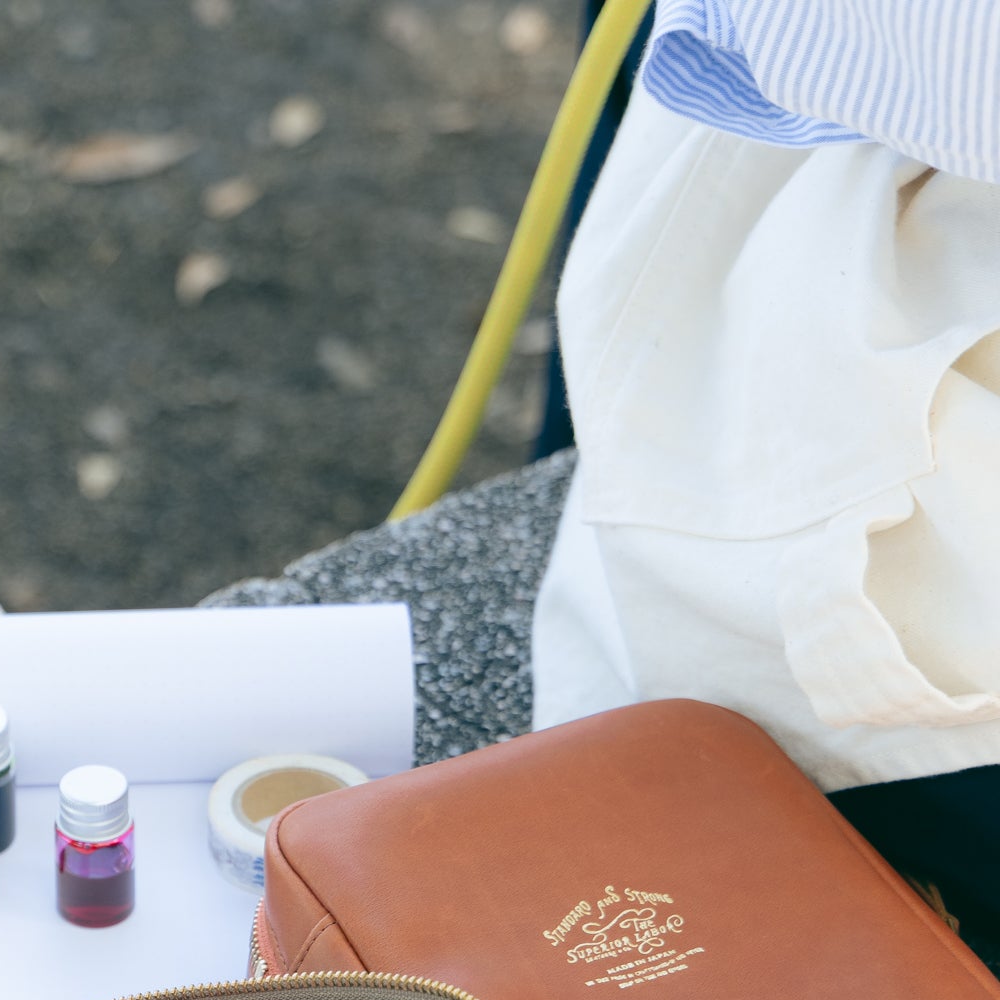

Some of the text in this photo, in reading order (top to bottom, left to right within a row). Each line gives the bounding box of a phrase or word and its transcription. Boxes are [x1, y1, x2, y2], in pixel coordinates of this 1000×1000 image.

[543, 885, 674, 946] STANDARD AND STRONG
[567, 936, 639, 963] SUPERIOR
[634, 915, 684, 943] LABOR
[647, 949, 677, 962] JAPAN
